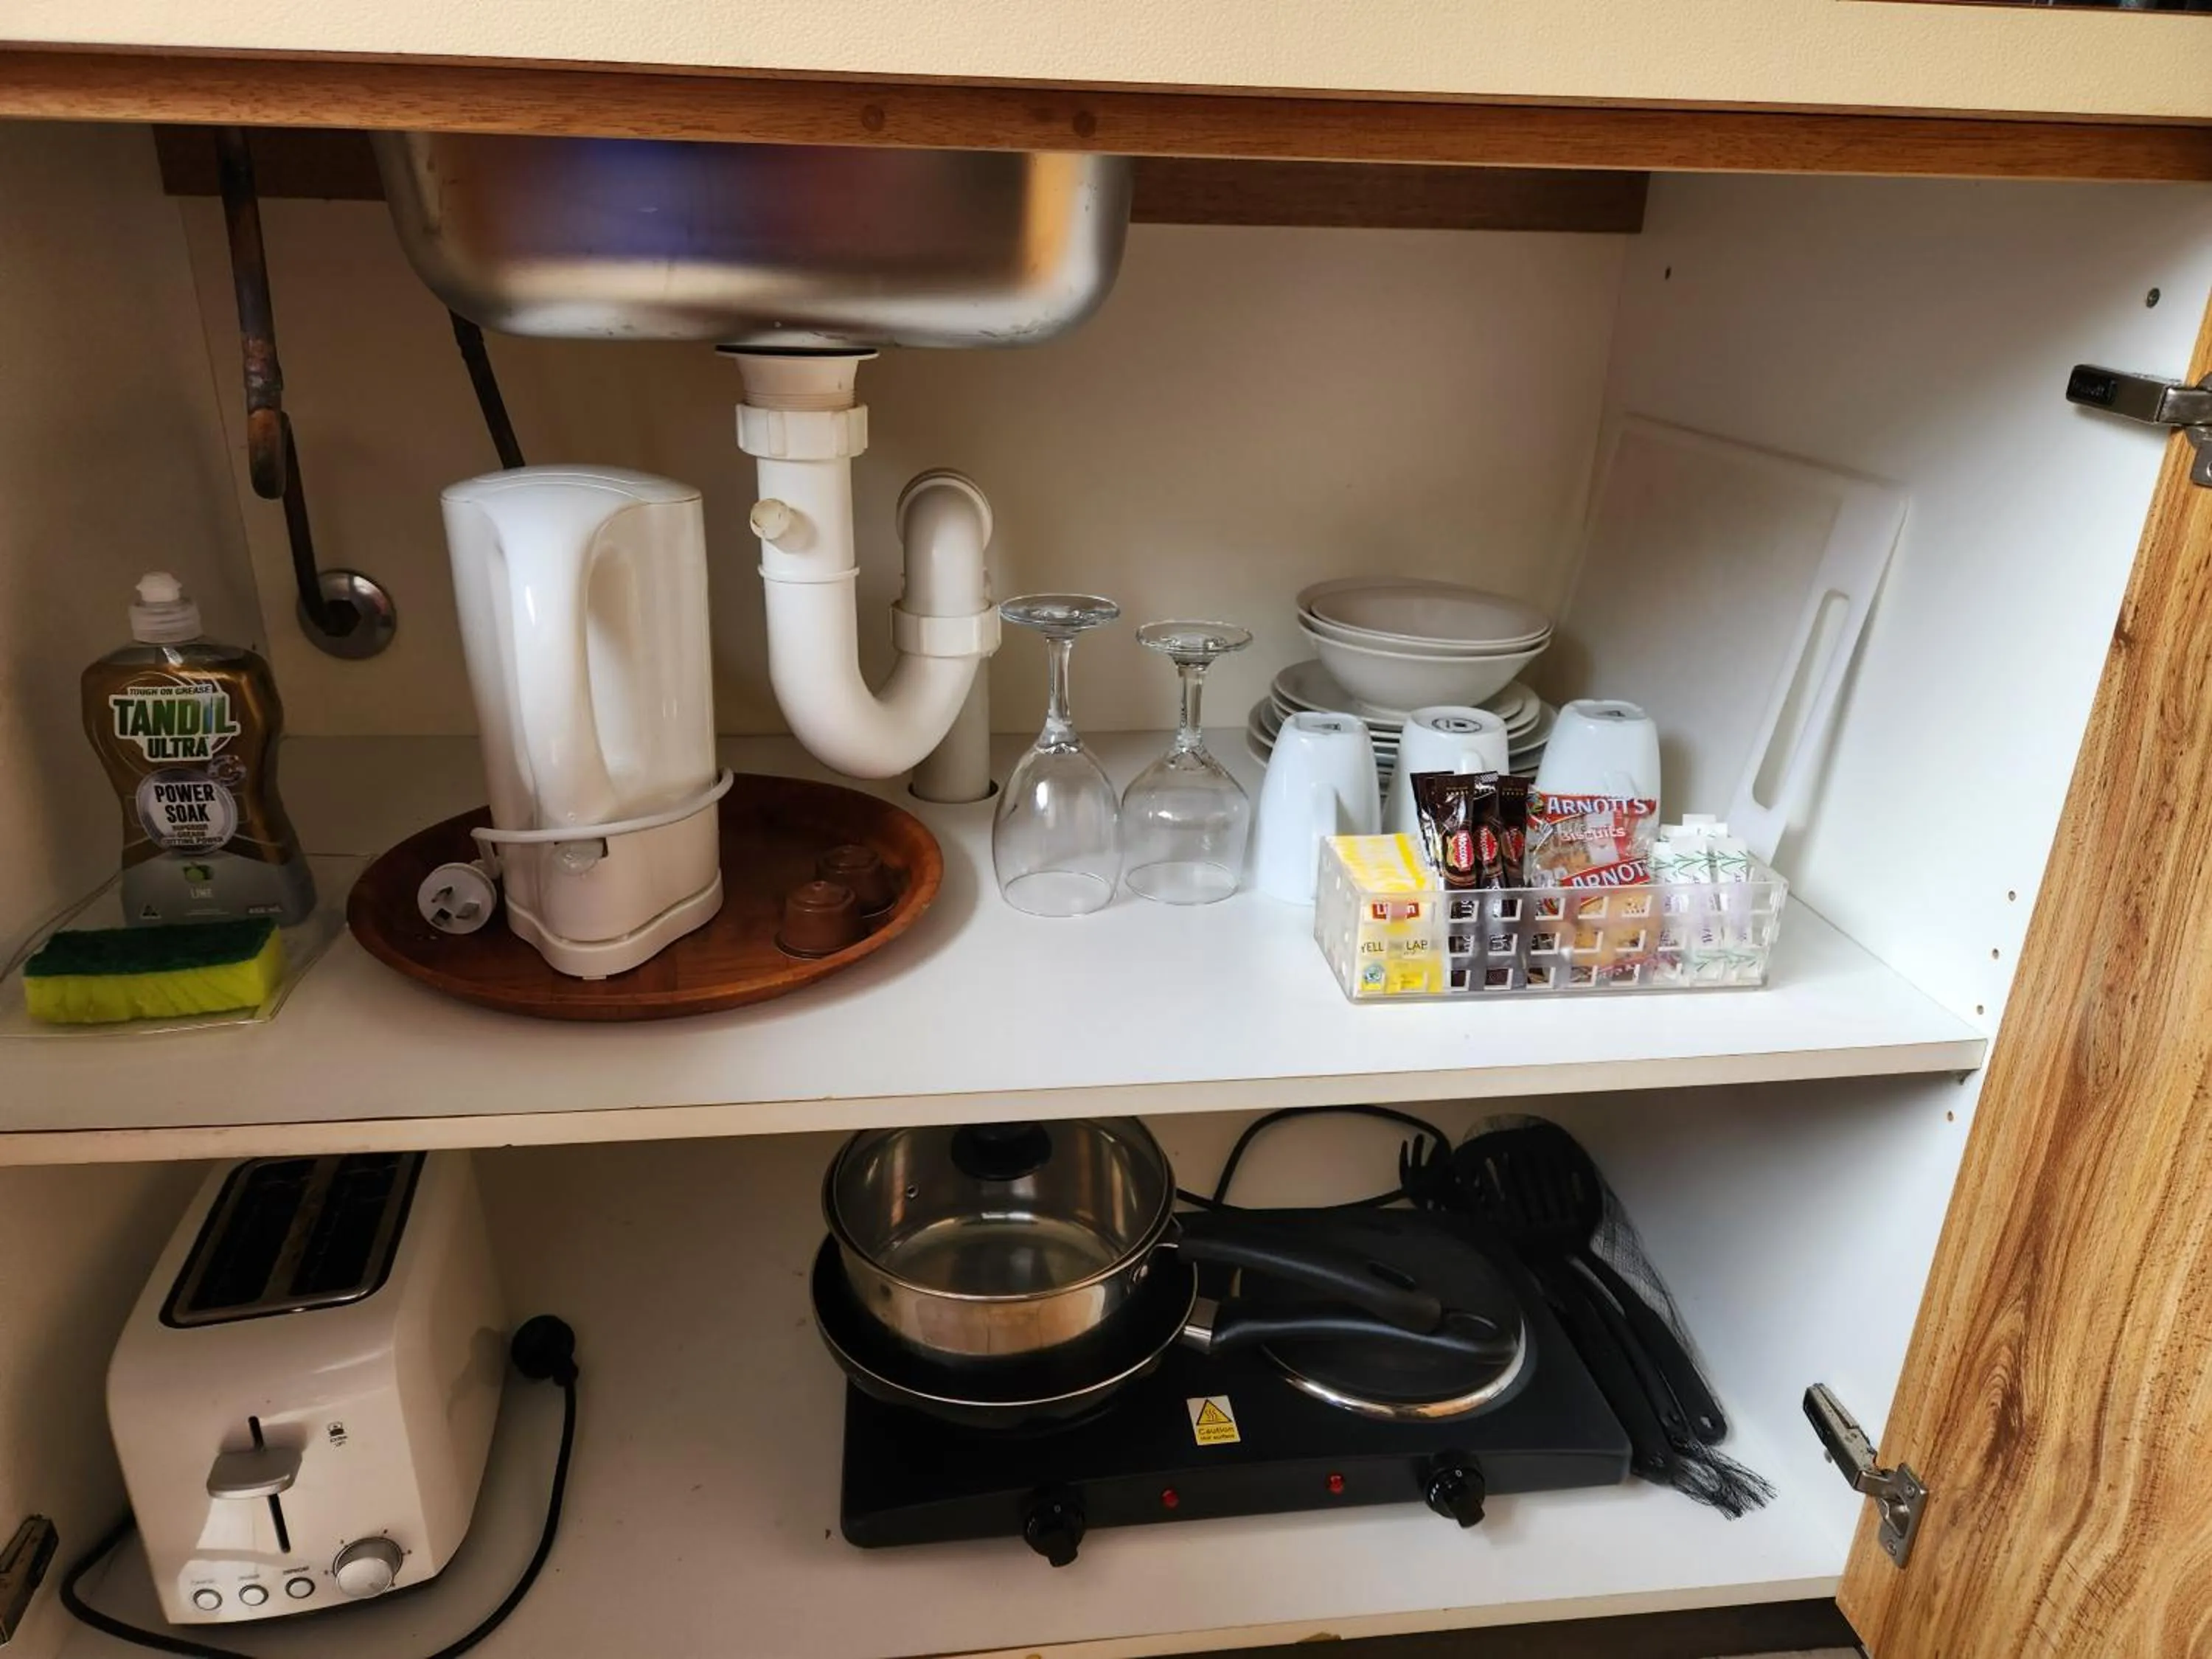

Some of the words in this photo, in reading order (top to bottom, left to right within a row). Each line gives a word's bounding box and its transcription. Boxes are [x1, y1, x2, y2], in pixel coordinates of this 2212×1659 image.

[175, 686, 212, 694] GREASE
[113, 697, 237, 736] TANDIL
[148, 737, 209, 758] ULTRA
[154, 784, 215, 803] POWER
[165, 803, 210, 823] SOAK
